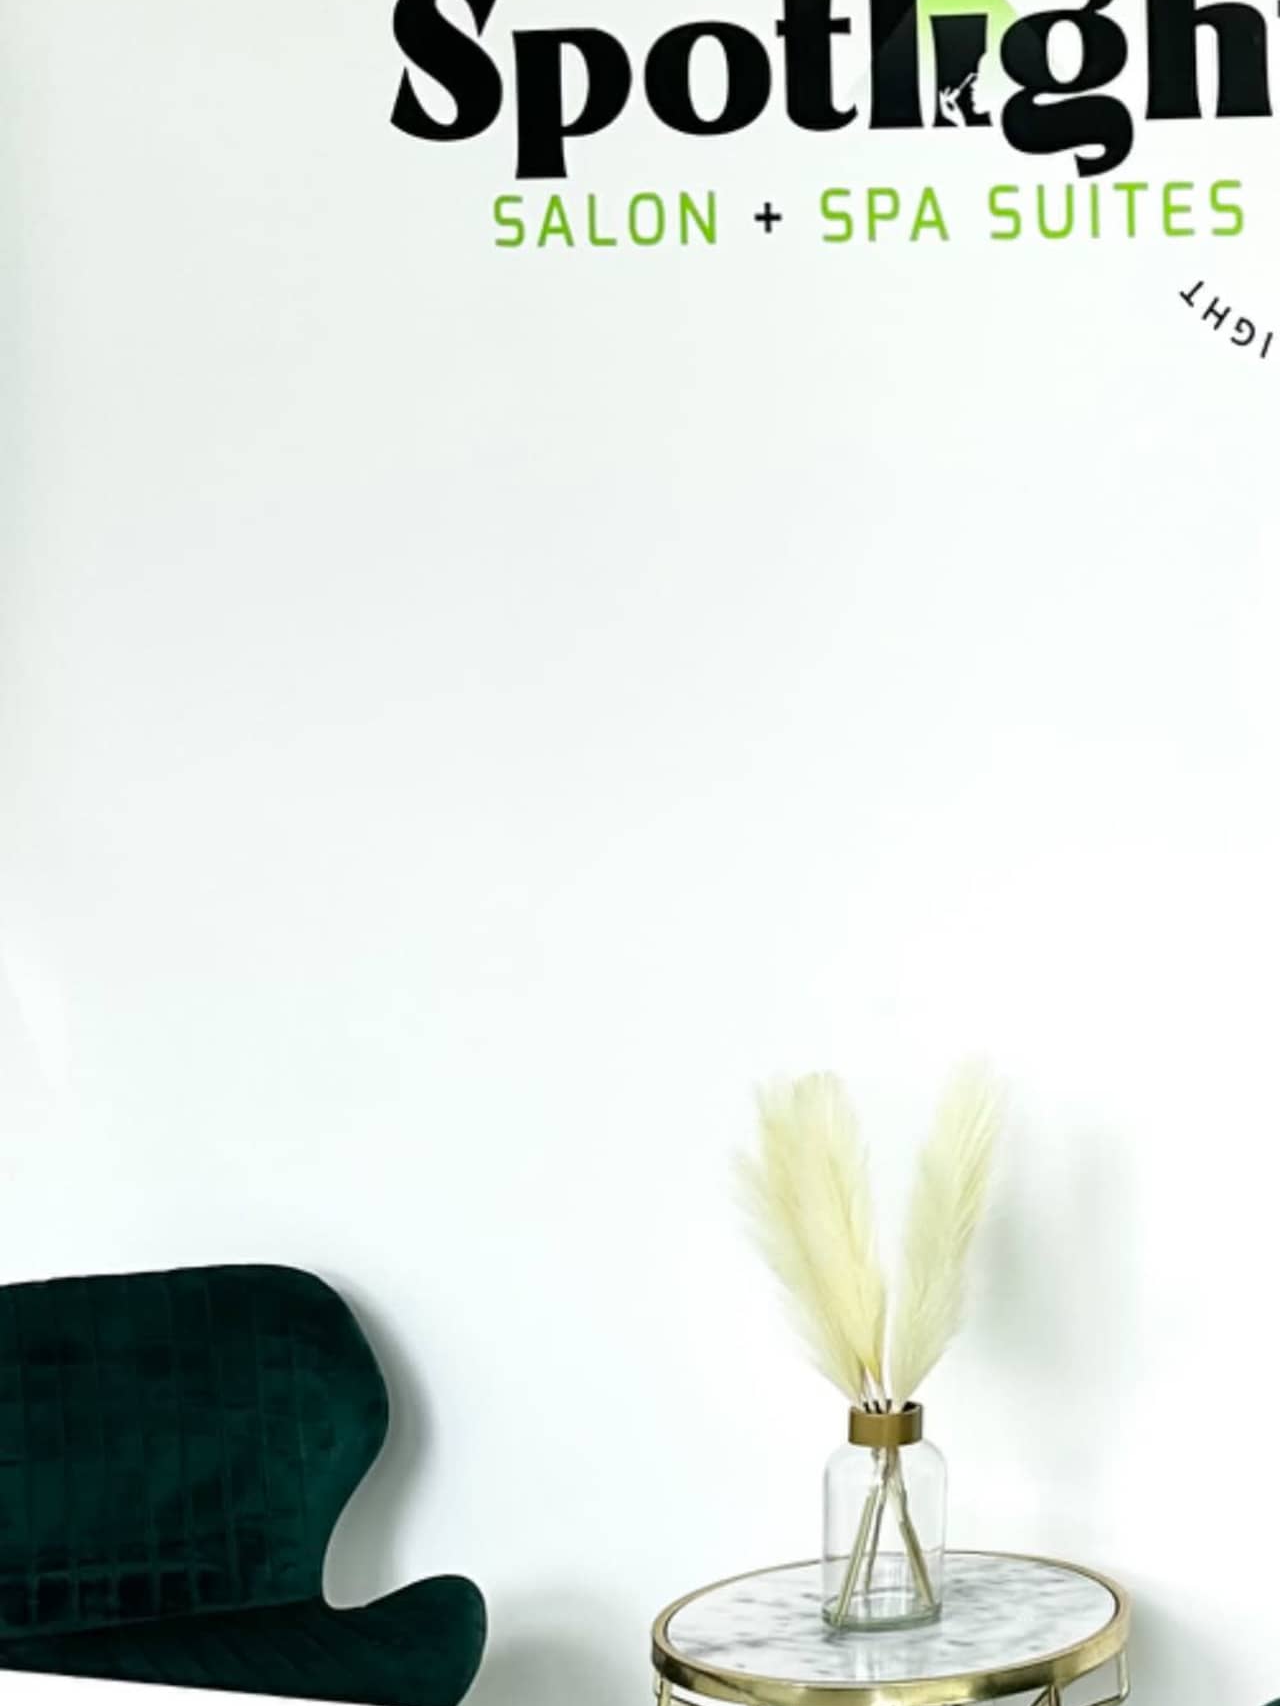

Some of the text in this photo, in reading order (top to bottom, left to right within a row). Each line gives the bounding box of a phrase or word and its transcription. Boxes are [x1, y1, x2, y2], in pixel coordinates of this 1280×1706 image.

[492, 191, 718, 248] SALON
[819, 185, 949, 244] SPA
[987, 178, 1245, 242] SUITES
